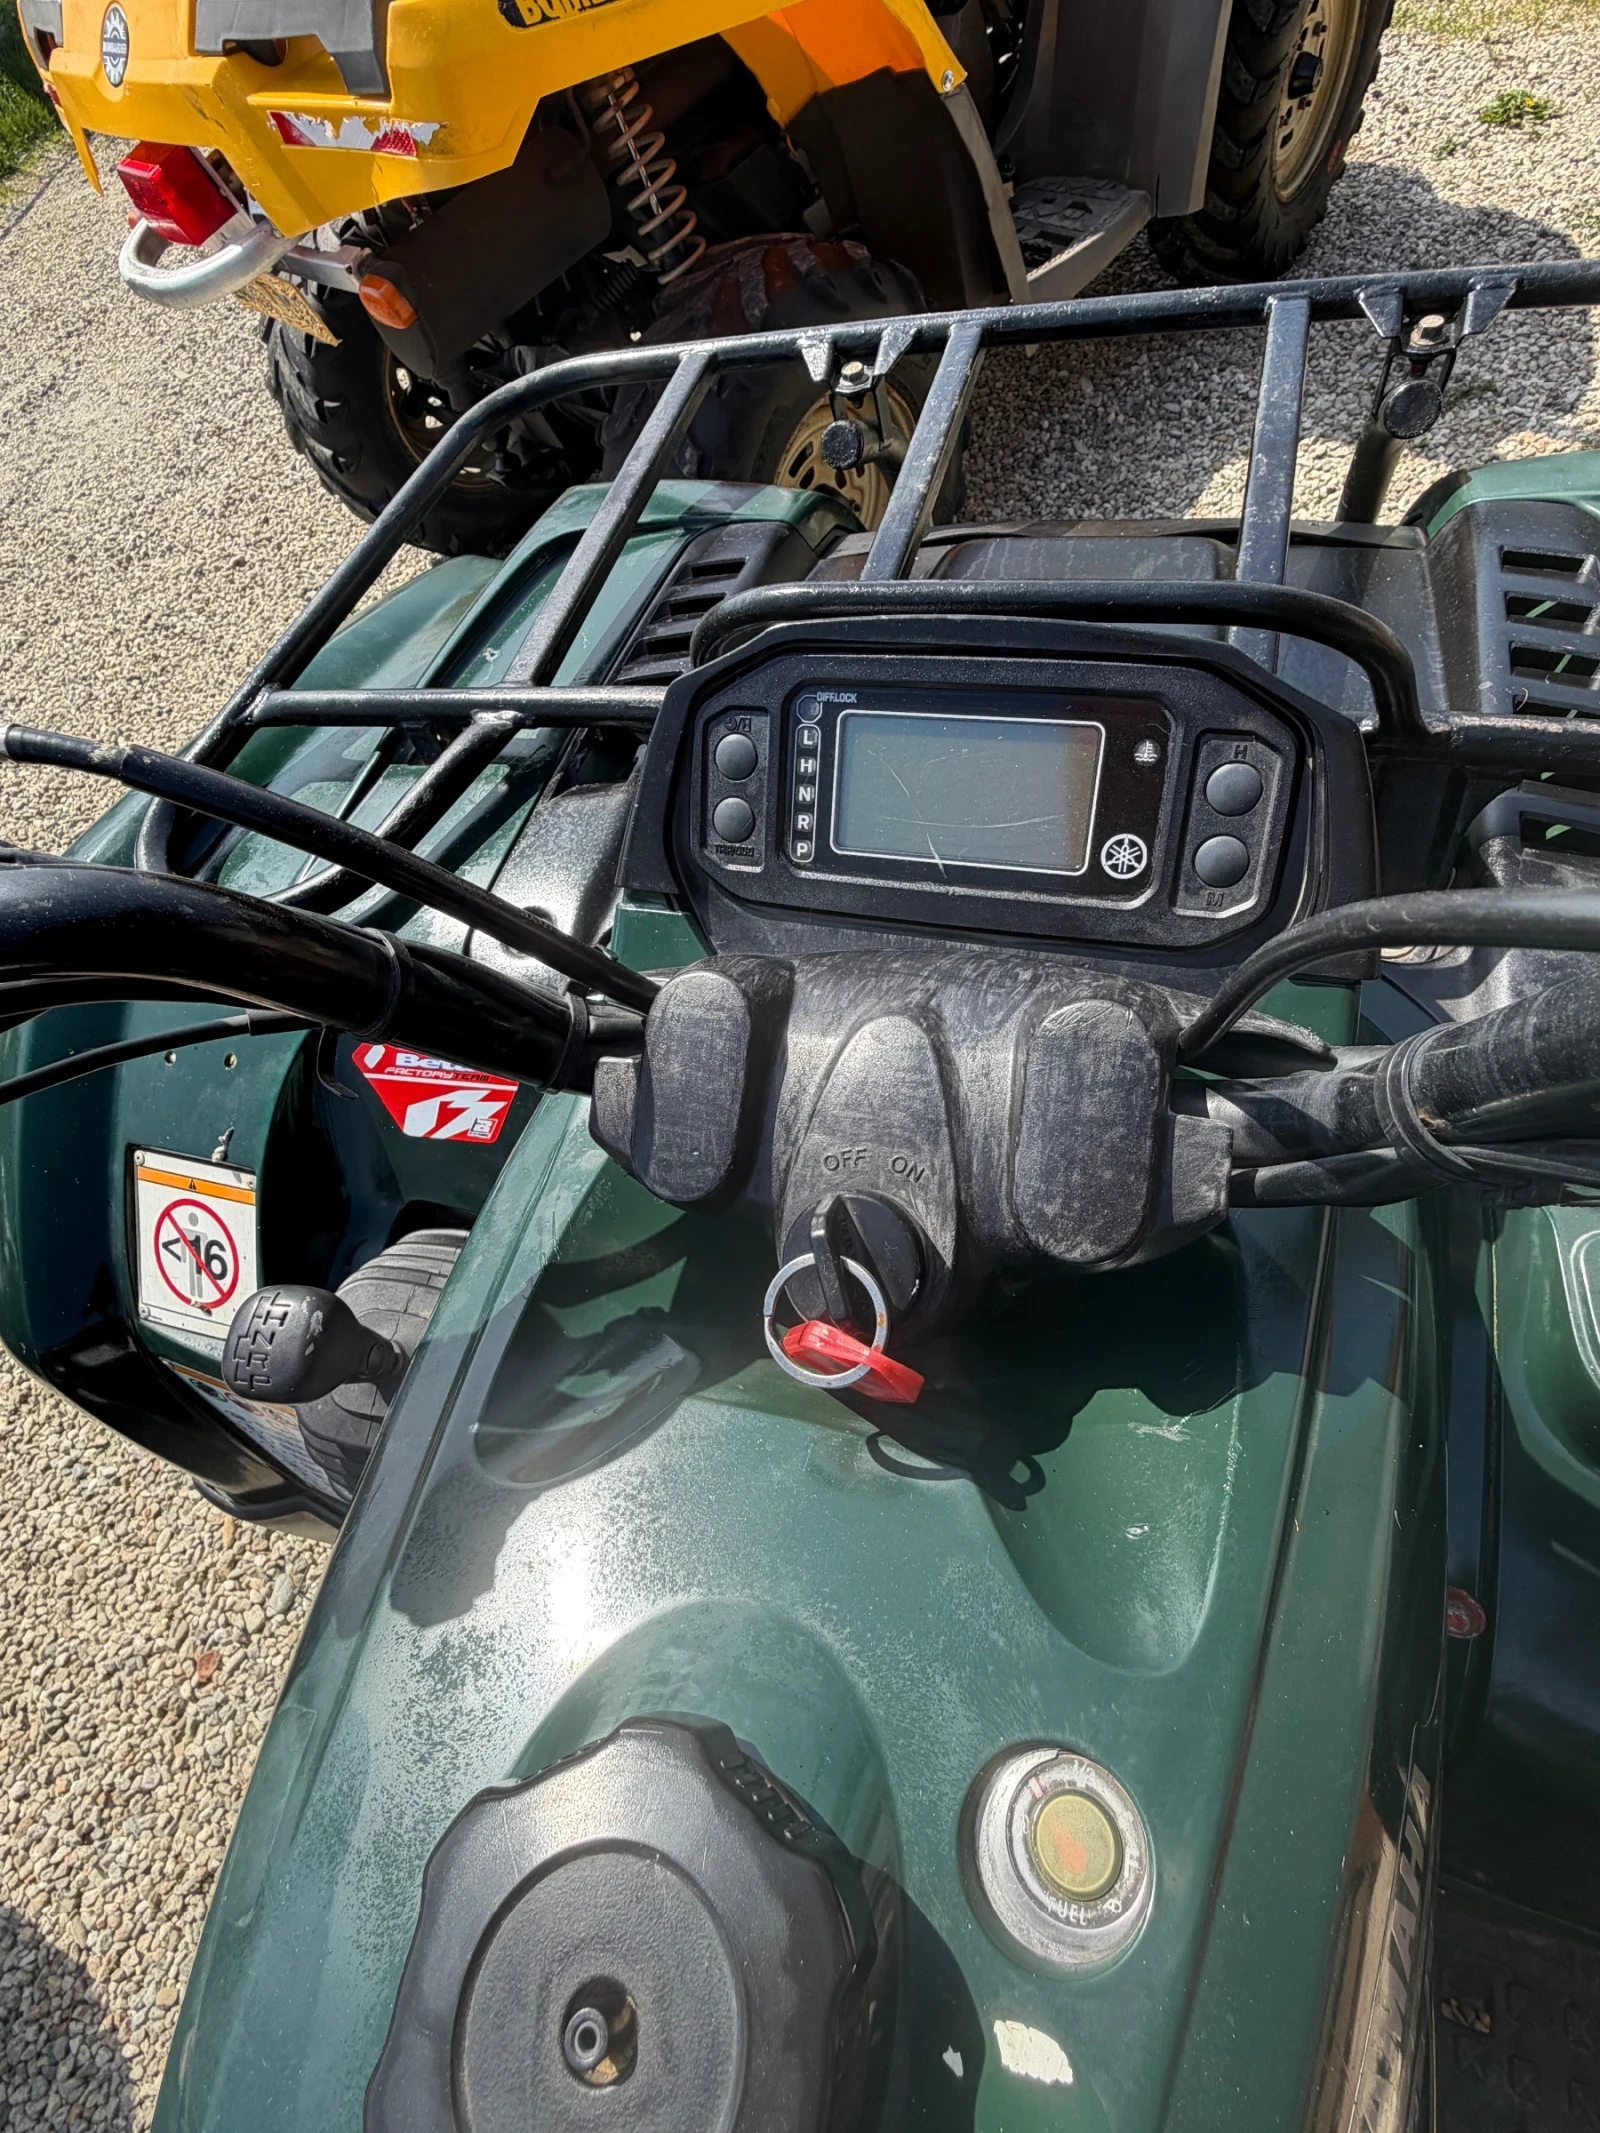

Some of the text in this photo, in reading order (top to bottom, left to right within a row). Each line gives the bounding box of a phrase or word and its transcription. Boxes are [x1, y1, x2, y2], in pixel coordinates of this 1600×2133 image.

[803, 729, 813, 745] L
[1233, 744, 1248, 759] H
[800, 759, 812, 773] H
[799, 787, 811, 801] N
[797, 815, 809, 830] R
[796, 843, 807, 857] P
[1205, 892, 1224, 907] M
[384, 1067, 490, 1082] FACTORY TEAM
[823, 1149, 925, 1182] OFF ON
[262, 1310, 289, 1328] H
[251, 1331, 276, 1350] N
[246, 1352, 269, 1371] R
[249, 1375, 272, 1392] P
[1047, 1896, 1089, 1926] FUEL
